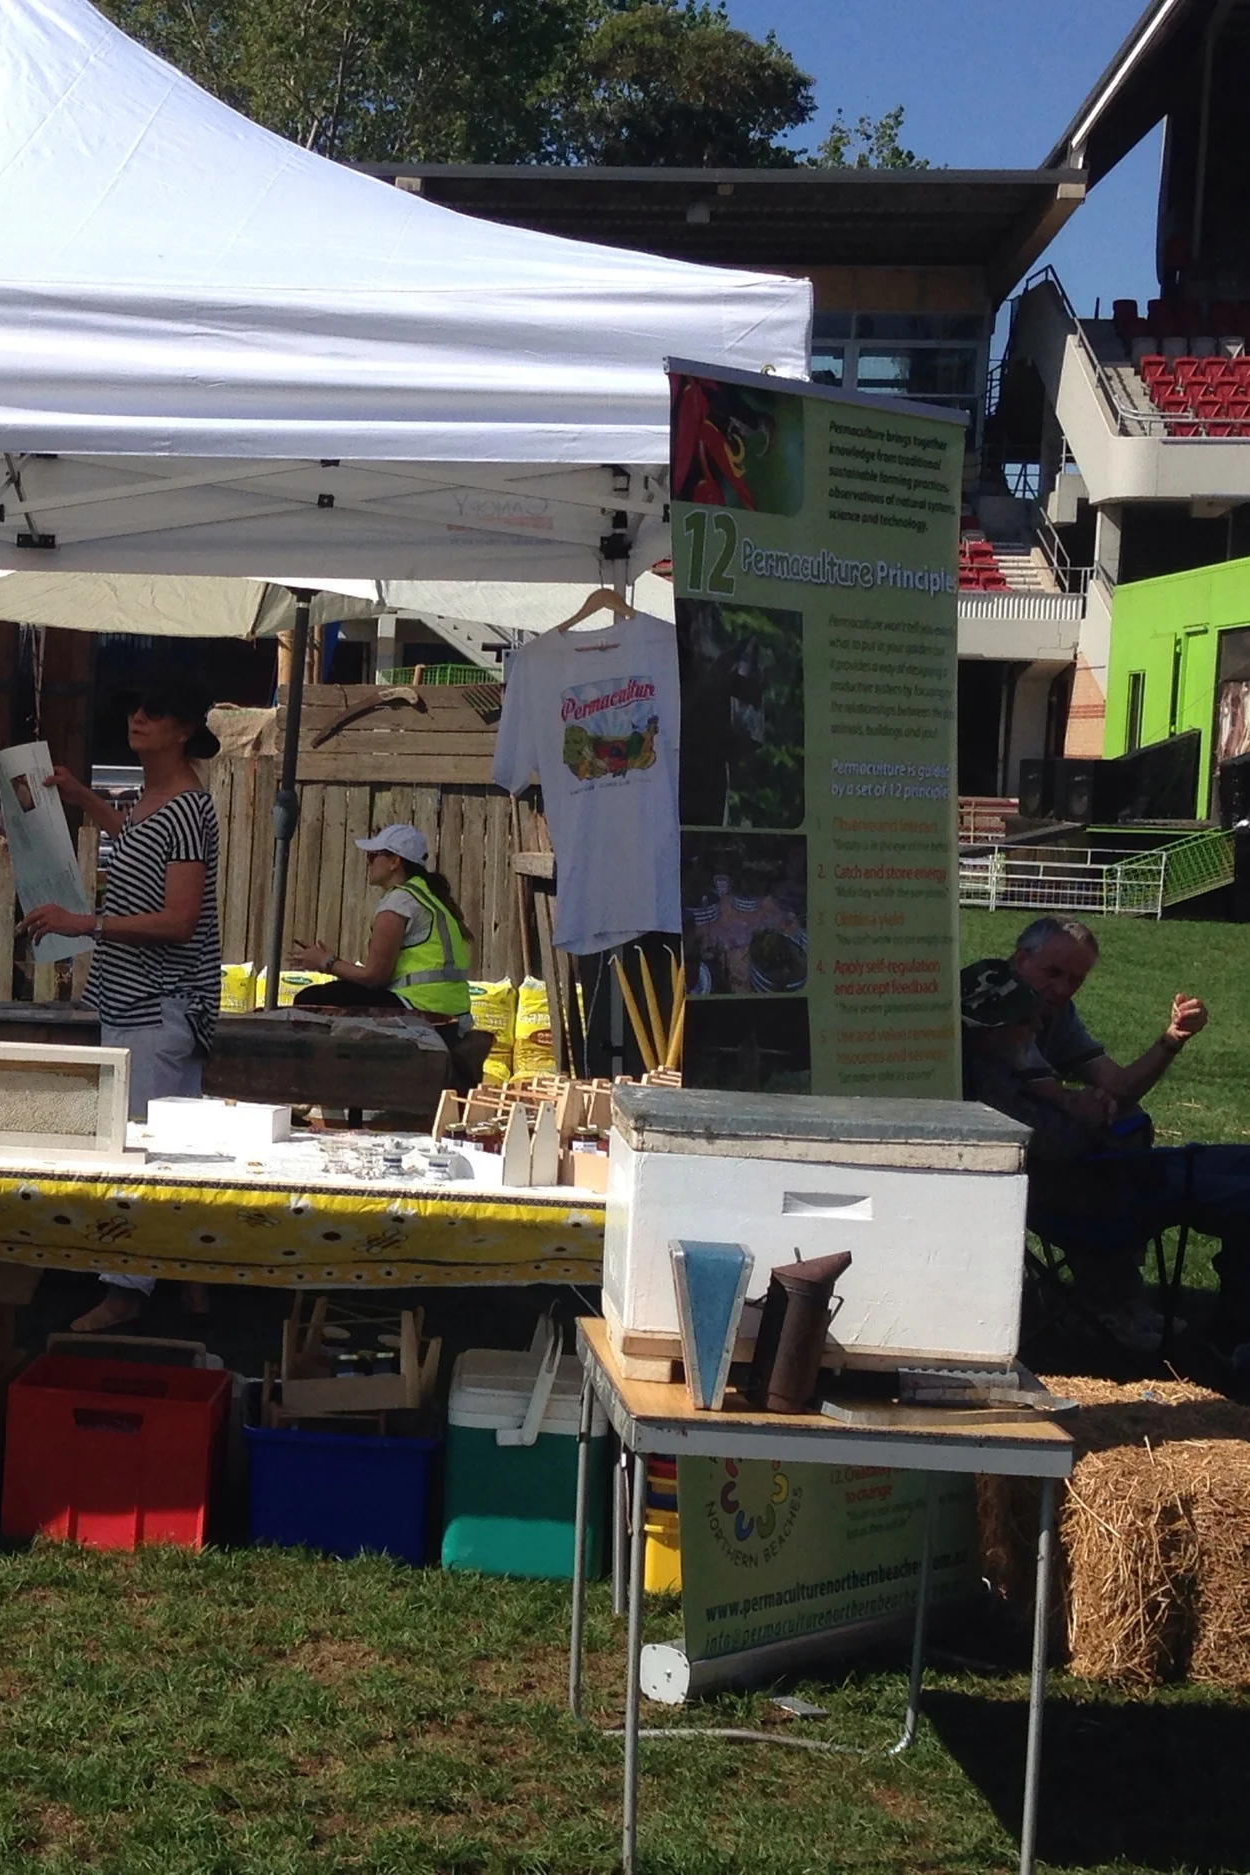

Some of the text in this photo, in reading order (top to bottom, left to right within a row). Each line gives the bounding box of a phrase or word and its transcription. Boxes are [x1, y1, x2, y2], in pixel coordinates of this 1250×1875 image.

[684, 509, 739, 597] 12
[740, 537, 875, 588] Permaculture
[560, 679, 656, 722] Permaculture
[831, 756, 905, 776] Permaculture
[907, 762, 916, 776] is
[831, 780, 845, 799] by
[845, 783, 854, 795] a
[856, 783, 873, 796] set
[874, 780, 887, 796] of
[889, 782, 902, 796] 12
[833, 864, 862, 879] Catch
[863, 864, 884, 880] and
[885, 866, 913, 880] store
[914, 868, 947, 884] energy
[833, 959, 865, 977] Apply
[865, 958, 941, 977] self-regulation
[834, 979, 939, 998] and accept feedback
[705, 1486, 803, 1568] NORTHERN BEACHES
